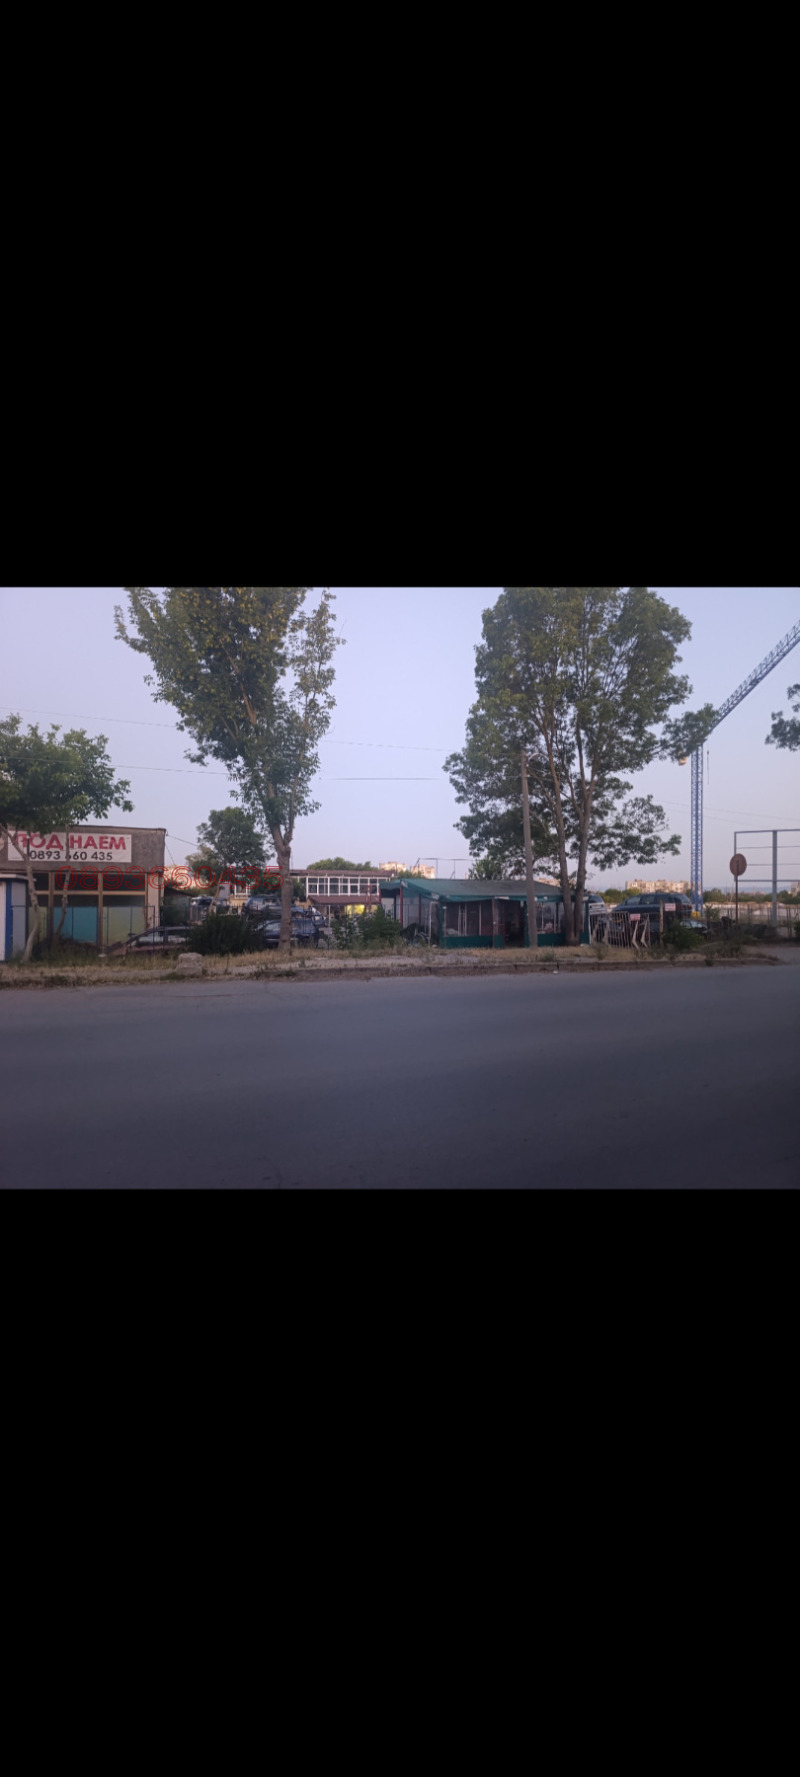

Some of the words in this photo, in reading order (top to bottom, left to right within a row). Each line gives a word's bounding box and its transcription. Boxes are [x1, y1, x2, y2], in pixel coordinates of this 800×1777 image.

[16, 833, 63, 850] ПОД
[70, 834, 126, 850] НАЕМ
[29, 850, 61, 860] 0893
[91, 851, 113, 861] 435
